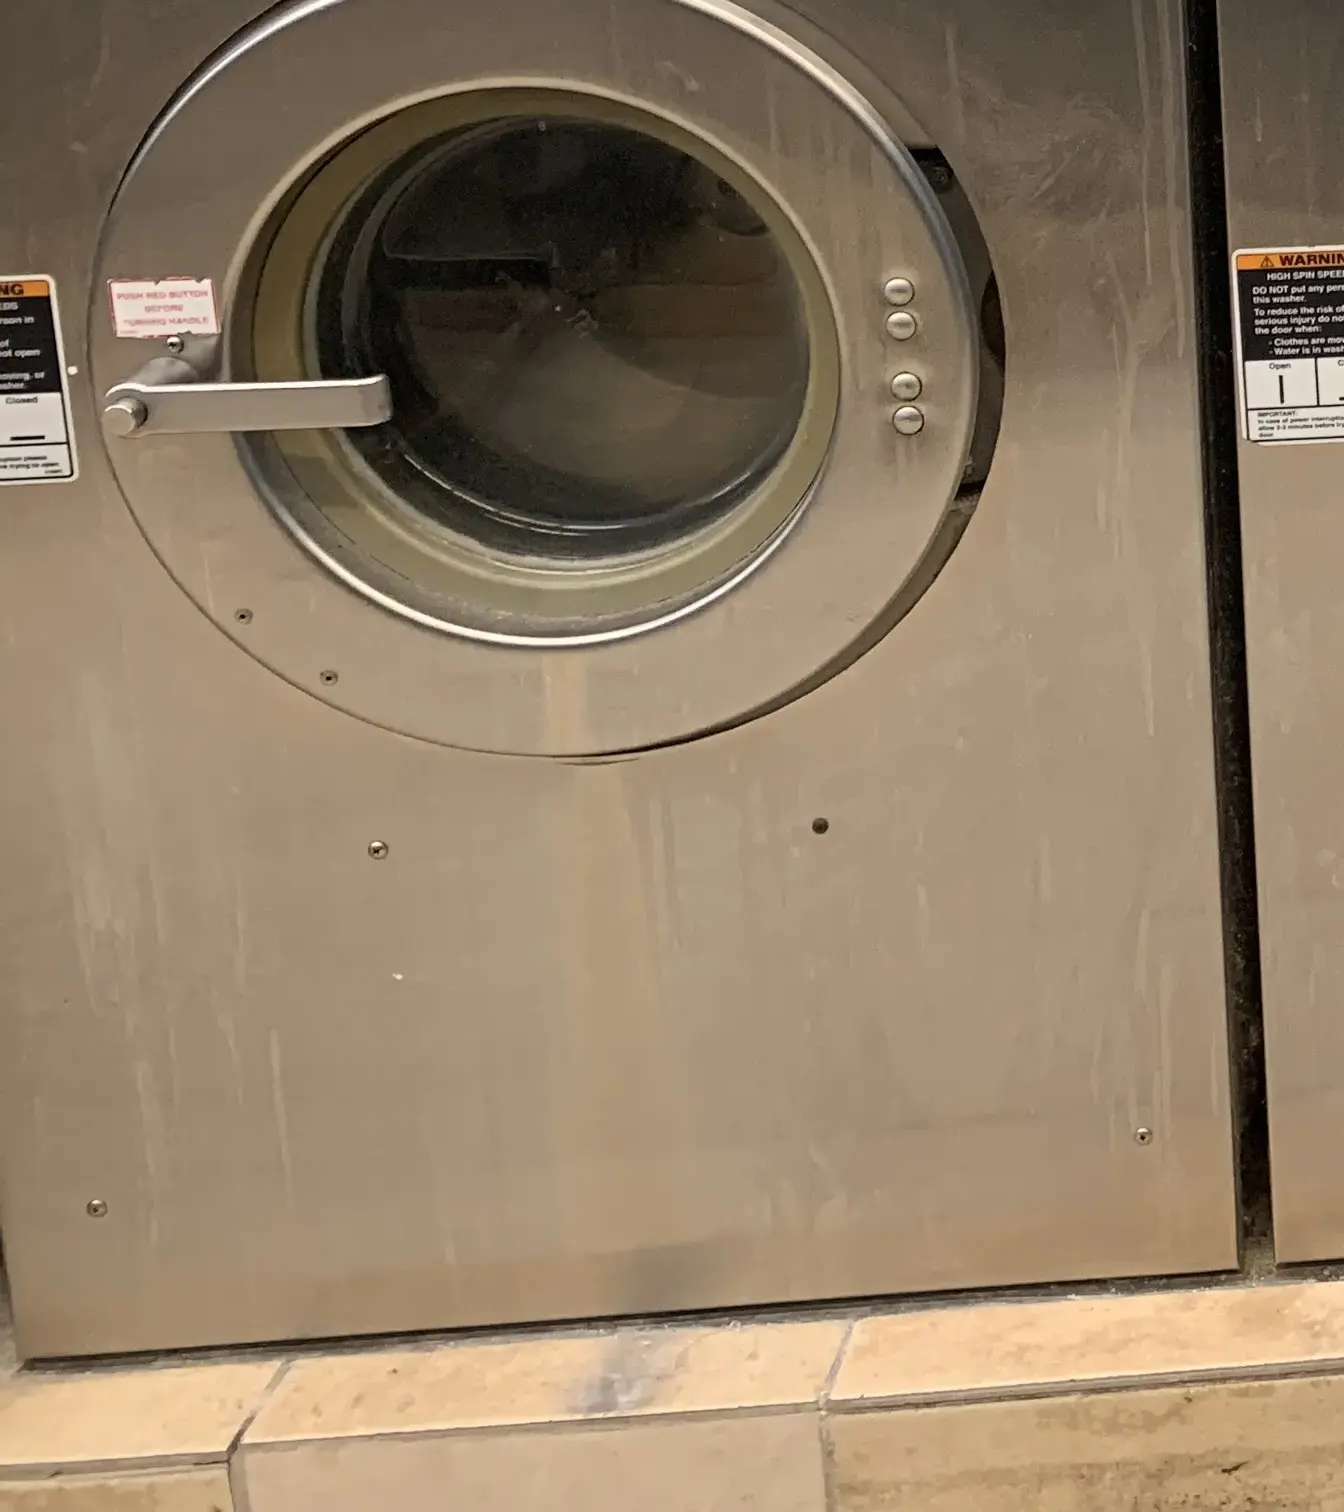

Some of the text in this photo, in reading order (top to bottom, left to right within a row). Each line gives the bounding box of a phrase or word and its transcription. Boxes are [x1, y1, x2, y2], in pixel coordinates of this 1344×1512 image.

[1267, 272, 1291, 281] HIGH
[1292, 271, 1315, 280] SPIN
[1252, 287, 1267, 295] DO
[1269, 286, 1288, 294] NOT
[1291, 287, 1306, 295] put
[1308, 285, 1325, 293] any
[1254, 308, 1265, 316] To
[1317, 305, 1333, 313] risk
[1335, 304, 1344, 312] of
[1254, 318, 1288, 326] serious
[1290, 316, 1316, 325] injury
[1318, 315, 1330, 323] do
[1274, 338, 1309, 346] Clothes
